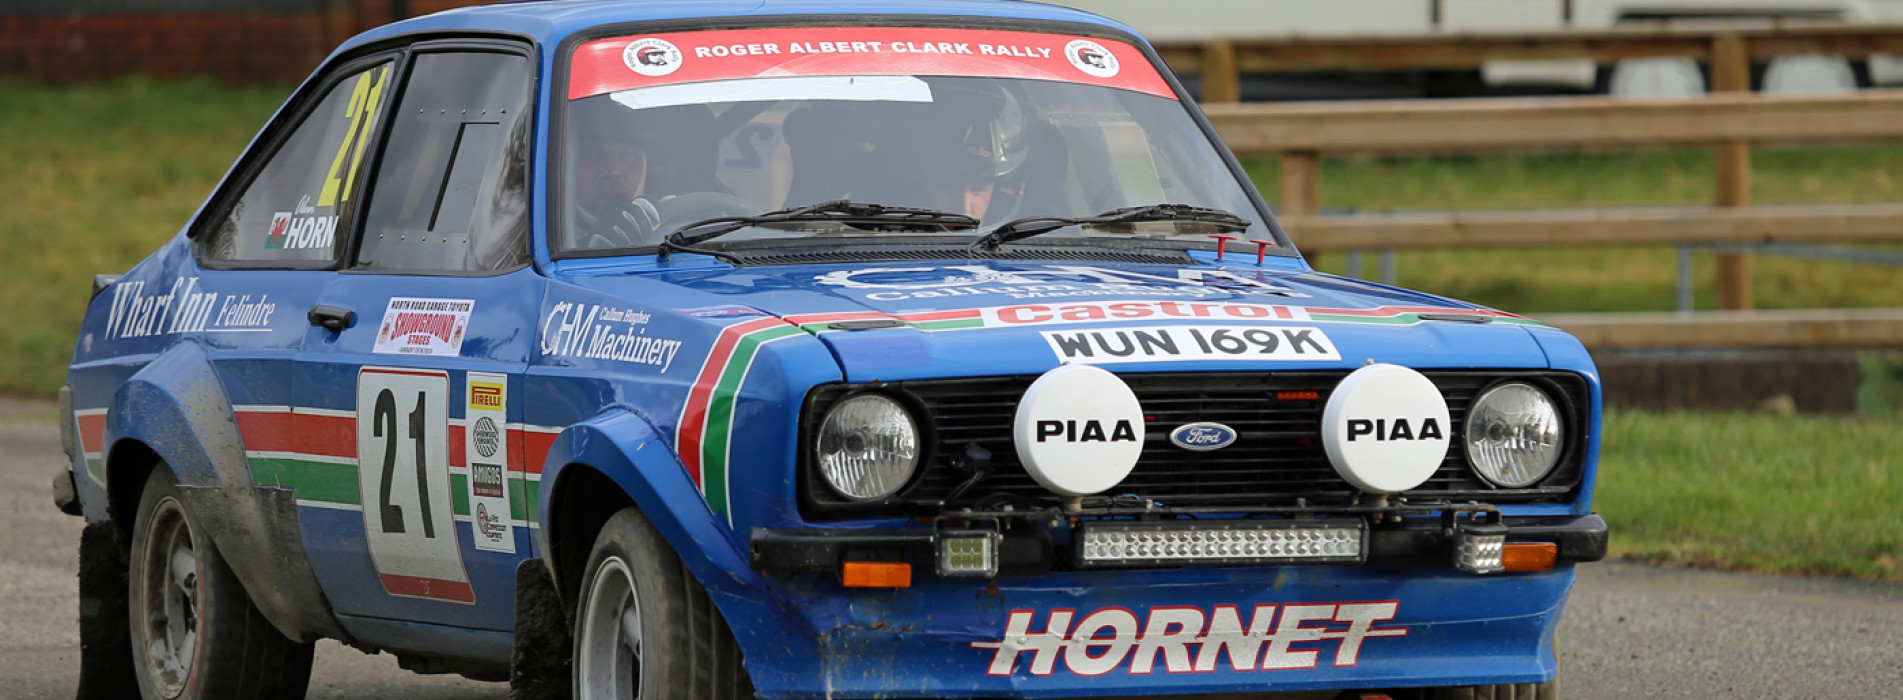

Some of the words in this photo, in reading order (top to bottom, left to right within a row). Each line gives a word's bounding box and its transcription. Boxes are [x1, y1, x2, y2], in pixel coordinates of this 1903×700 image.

[694, 43, 781, 58] ROGER
[789, 41, 882, 55] ALBERT
[891, 41, 973, 55] CLARK
[979, 43, 1052, 59] RALLY
[317, 67, 389, 207] 21
[283, 215, 340, 249] HORN
[105, 275, 185, 340] Wharf
[166, 277, 218, 335] Inn
[214, 294, 276, 327] Felindre
[391, 301, 410, 310] NORTH
[410, 301, 426, 311] ROAD
[426, 301, 449, 312] GARAGE
[449, 302, 470, 312] TOYOTA
[599, 306, 625, 322] Callum
[997, 301, 1294, 324] Castrol
[390, 312, 456, 343] SHOWGROUND
[407, 334, 432, 346] STAGES
[585, 324, 682, 374] Machinery
[1051, 330, 1181, 358] WUN
[1188, 328, 1329, 354] 169K
[472, 386, 501, 407] PIRELLI
[1036, 419, 1137, 442] PIAA
[1186, 427, 1221, 444] Ford
[1347, 418, 1443, 441] PIAA
[373, 388, 436, 539] 21
[987, 600, 1400, 677] HORNET
